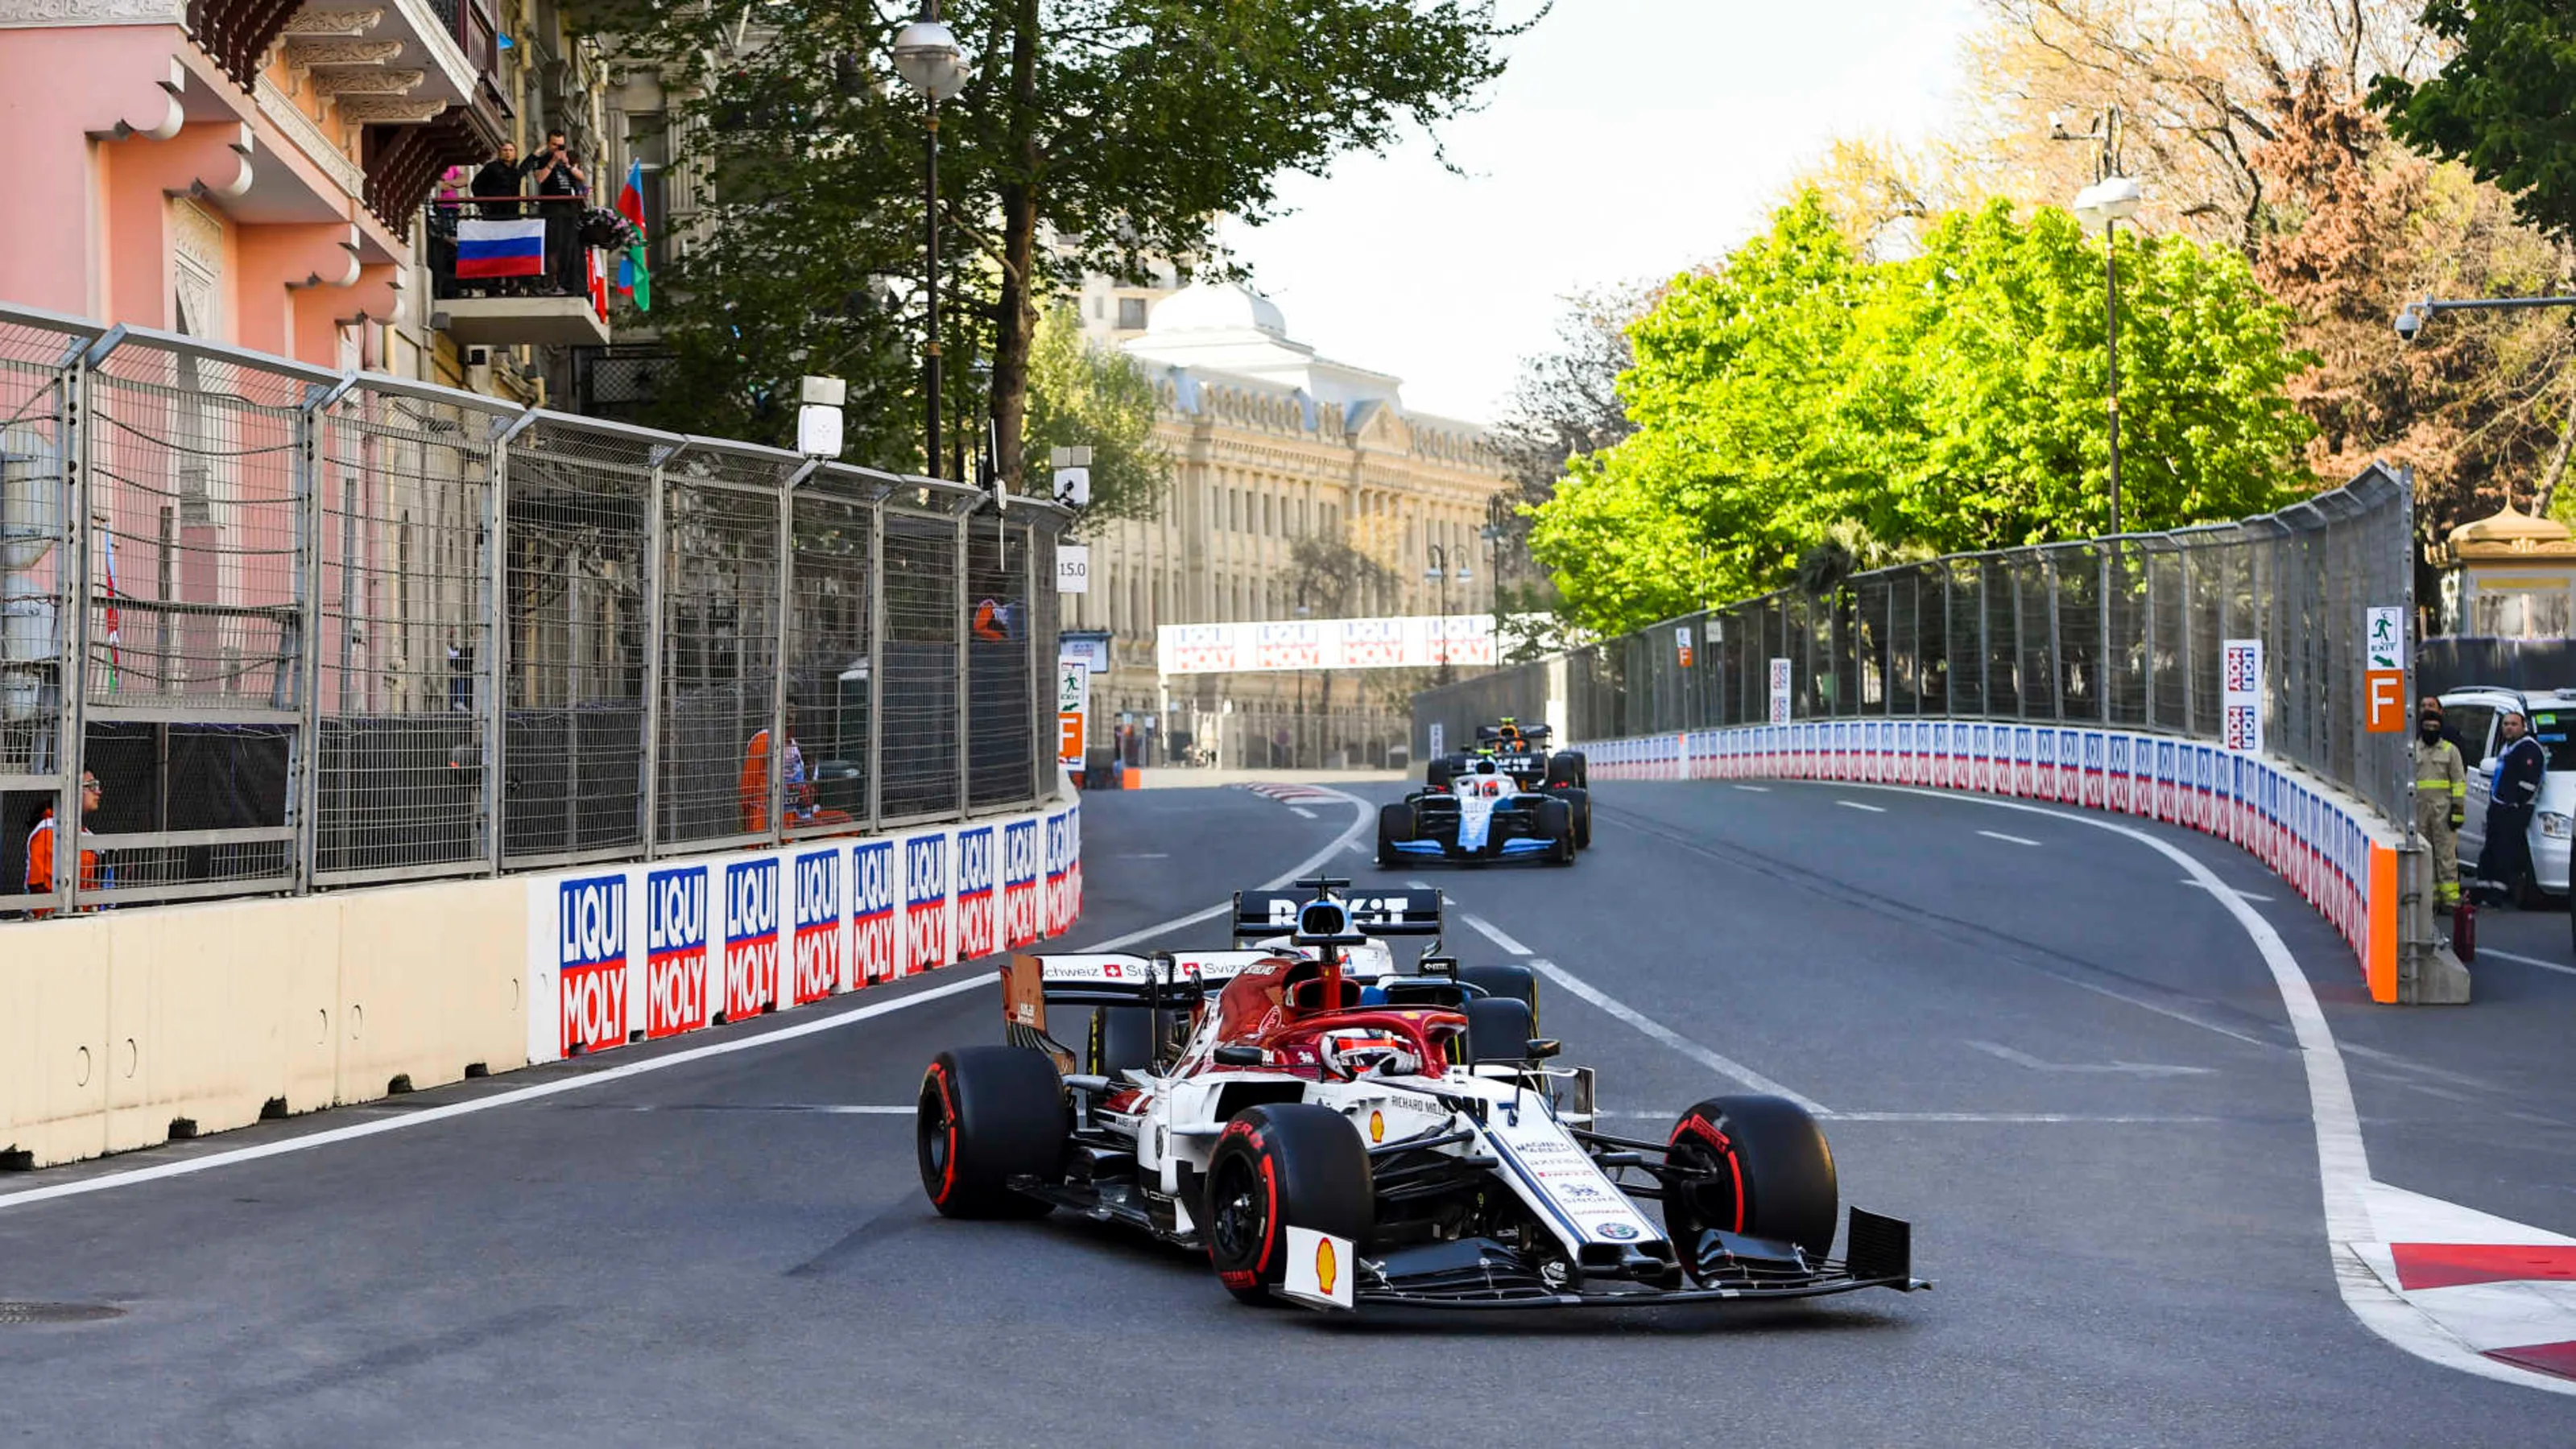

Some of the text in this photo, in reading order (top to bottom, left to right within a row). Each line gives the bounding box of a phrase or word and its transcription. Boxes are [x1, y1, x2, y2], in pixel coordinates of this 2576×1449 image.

[1061, 562, 1085, 576] 15.0
[2229, 649, 2242, 691] MOLY
[2229, 707, 2242, 749] MOLY
[2371, 678, 2396, 724] F
[1059, 718, 1078, 753] F
[855, 848, 894, 913] LIQUI
[908, 841, 945, 902] LIQUI
[959, 832, 993, 892] LIQUI
[1006, 824, 1036, 882] LIQUI
[650, 874, 706, 949] LIQUI
[728, 865, 777, 937] LIQUI
[797, 856, 838, 924] LIQUI
[1006, 886, 1036, 944] MOLY
[563, 883, 624, 962] LIQUI
[855, 915, 894, 984] MOLY
[908, 906, 945, 969] MOLY
[959, 896, 993, 956] MOLY
[650, 955, 706, 1031] MOLY
[727, 941, 778, 1016] MOLY
[796, 928, 839, 999] MOLY
[1044, 966, 1100, 977] chweiz
[564, 967, 626, 1050] MOLY
[1391, 1096, 1446, 1117] RICHARD MILLE
